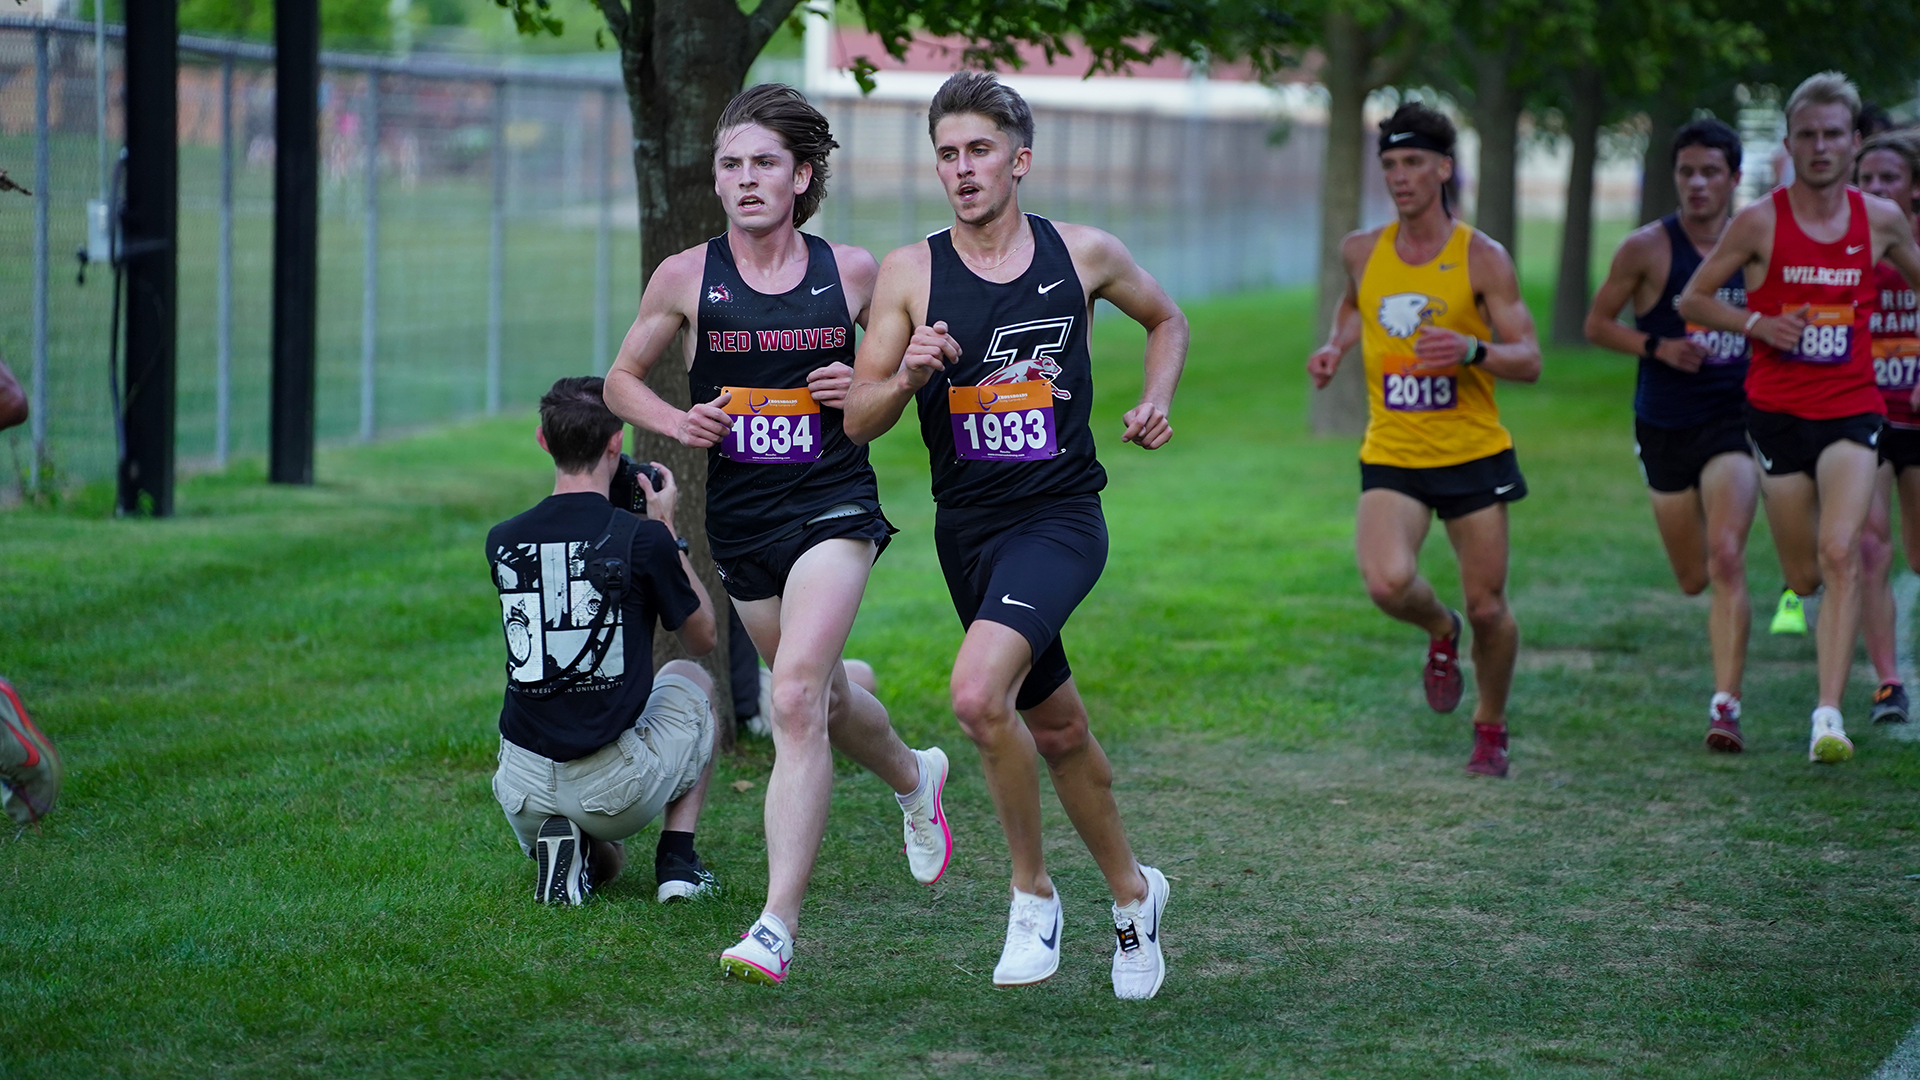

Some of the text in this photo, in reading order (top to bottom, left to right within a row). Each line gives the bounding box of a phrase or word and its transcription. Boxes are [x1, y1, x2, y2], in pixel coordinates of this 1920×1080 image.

[707, 326, 846, 352] RED WOLVES
[1872, 356, 1920, 386] 207
[1387, 373, 1452, 406] 2013
[731, 414, 813, 454] 1834
[962, 409, 1047, 452] 1933
[575, 680, 624, 693] UNIVERSITY
